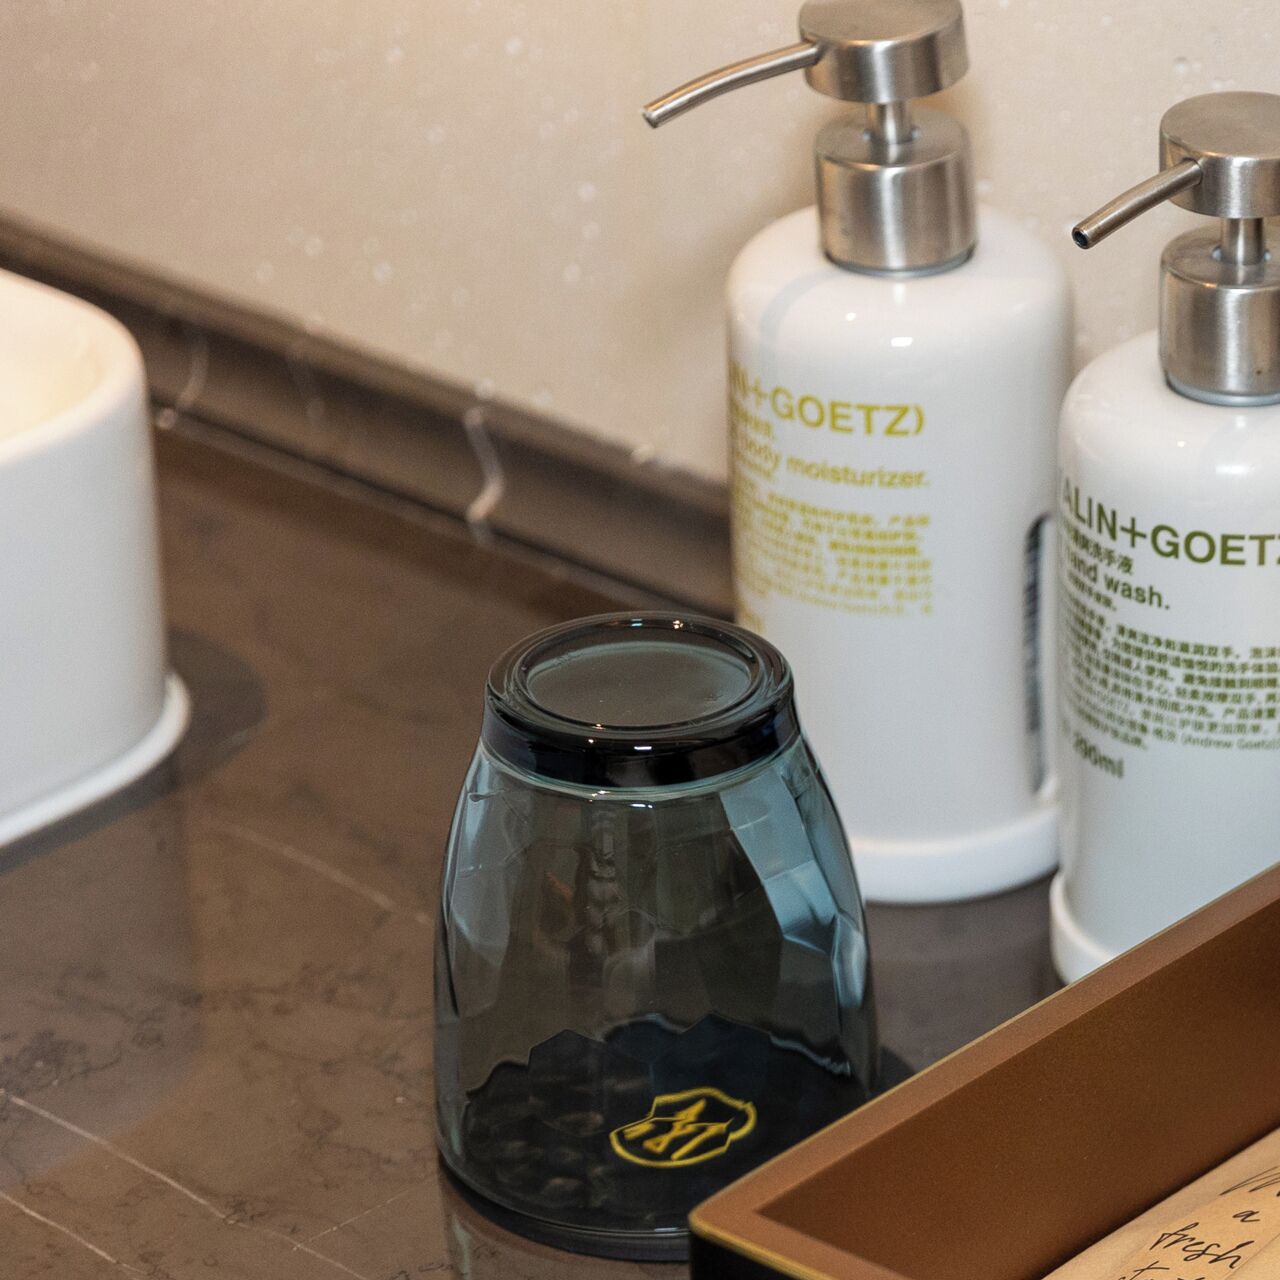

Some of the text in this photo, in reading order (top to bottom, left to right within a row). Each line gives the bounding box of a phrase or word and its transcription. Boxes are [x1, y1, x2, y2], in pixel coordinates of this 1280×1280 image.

[786, 456, 929, 488] moisturizer.
[1104, 572, 1170, 610] wash.
[1232, 1209, 1261, 1224] a
[1149, 1222, 1255, 1270] fresh
